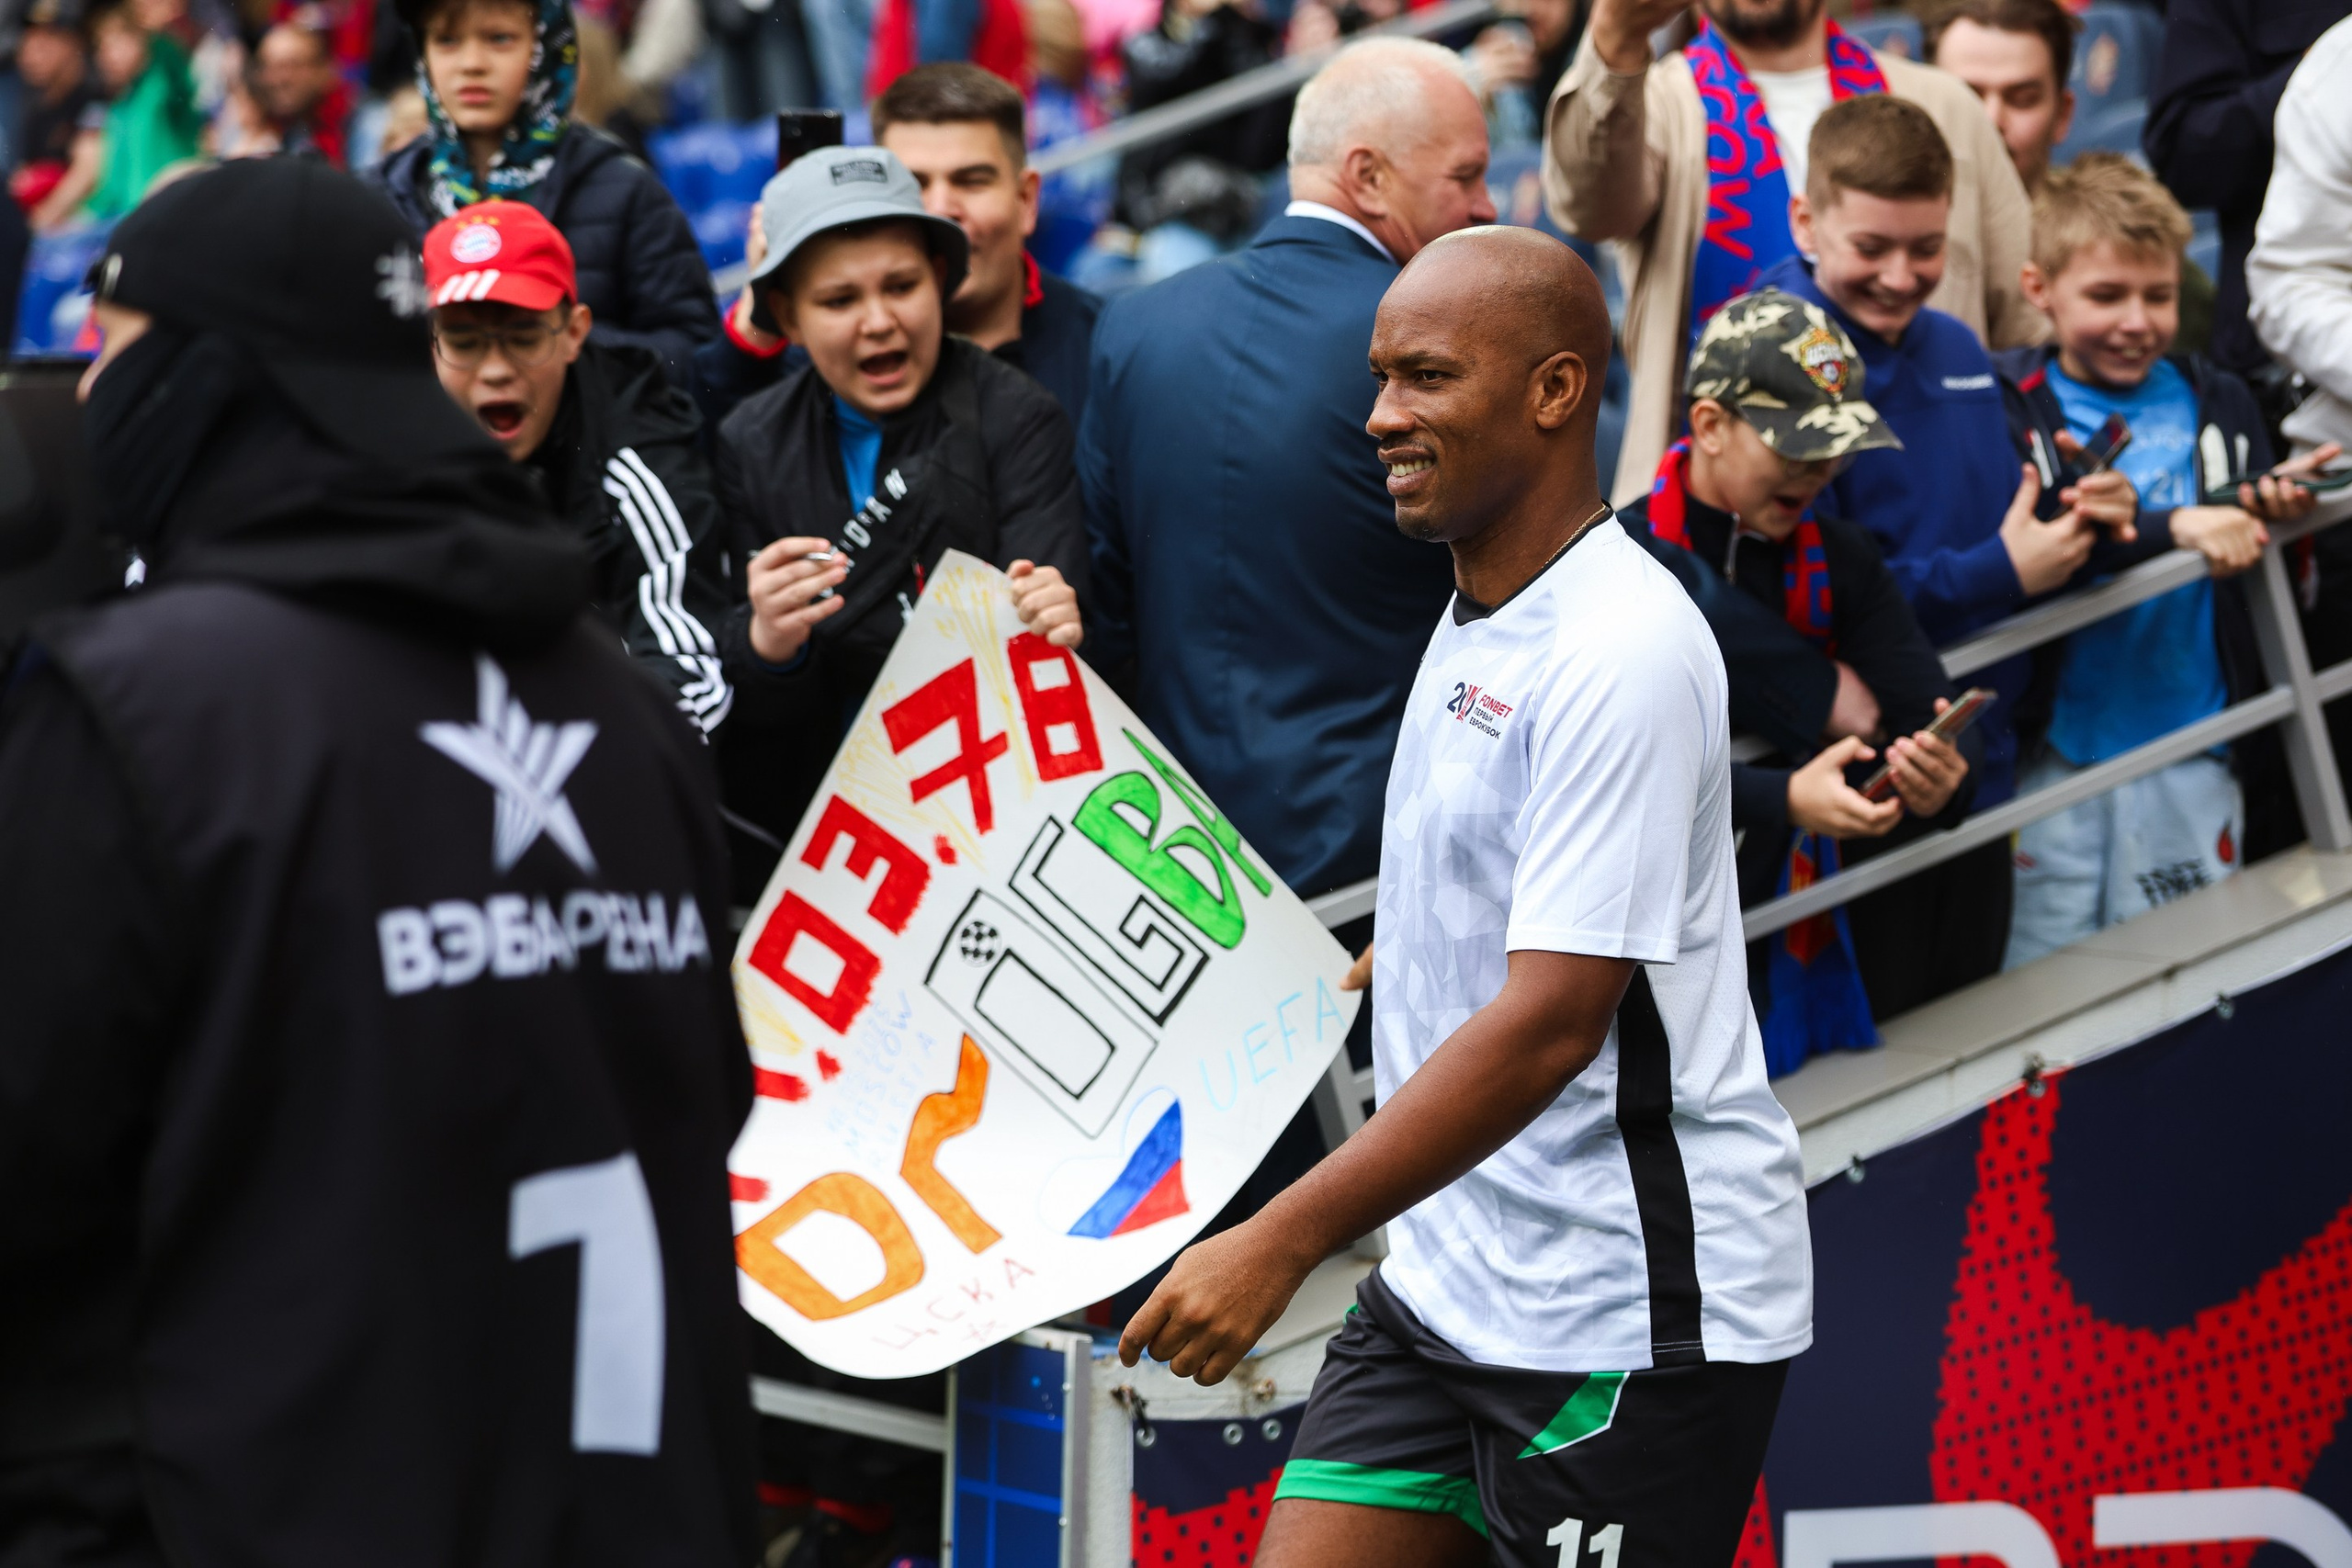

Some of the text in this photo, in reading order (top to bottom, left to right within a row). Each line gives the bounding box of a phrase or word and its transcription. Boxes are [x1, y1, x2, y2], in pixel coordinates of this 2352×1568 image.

[1468, 716, 1501, 740] ЕВРОКУБОК
[1473, 706, 1496, 724] ПЕРВЫЙ
[1477, 694, 1513, 718] FONBET
[1198, 976, 1348, 1112] UEFA
[508, 1148, 668, 1453] 1
[872, 1257, 1036, 1350] ЦСКА
[1545, 1517, 1625, 1568] 11
